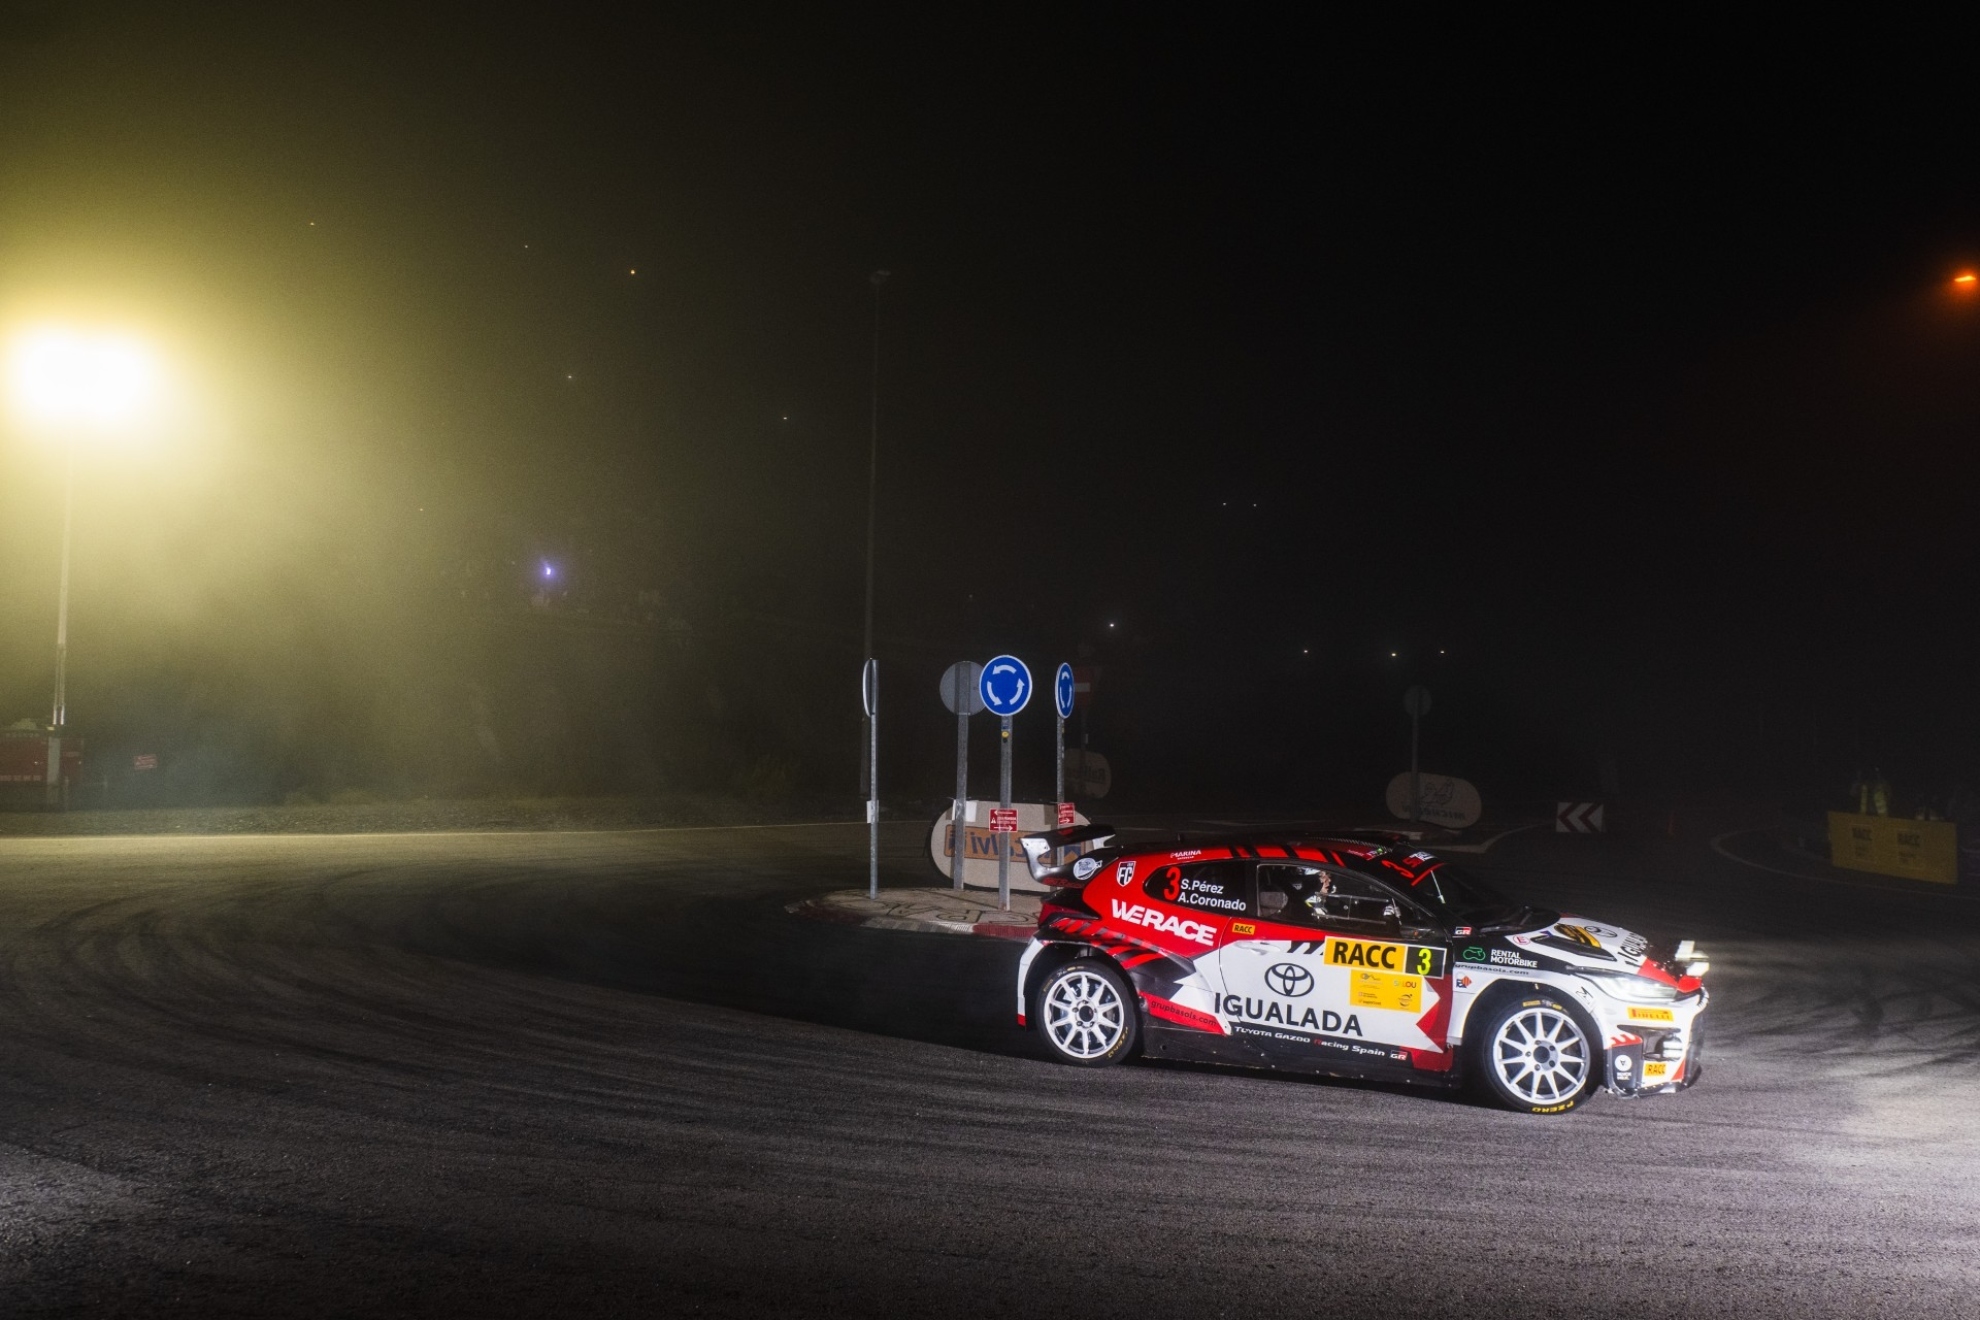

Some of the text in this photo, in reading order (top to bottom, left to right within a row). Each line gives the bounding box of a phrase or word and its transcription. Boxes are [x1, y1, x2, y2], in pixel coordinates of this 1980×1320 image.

[1118, 866, 1133, 886] FC
[1163, 866, 1181, 901] 3
[1180, 878, 1224, 895] S.Pérez
[1178, 892, 1247, 912] A.Coronado
[1111, 898, 1217, 946] WERACE
[1233, 924, 1253, 934] RACC
[1455, 927, 1472, 936] GR
[1332, 941, 1397, 970] RACC
[1416, 948, 1432, 976] 3
[1490, 949, 1521, 960] RENTAL
[1490, 957, 1538, 968] MOTORBIKE
[1151, 999, 1218, 1027] grupbasols.com
[1214, 991, 1363, 1037] IGUALADA
[1274, 1032, 1311, 1044] GAZOO
[1313, 1038, 1349, 1050] Racing
[1351, 1044, 1386, 1057] Spain
[1389, 1053, 1407, 1061] GR
